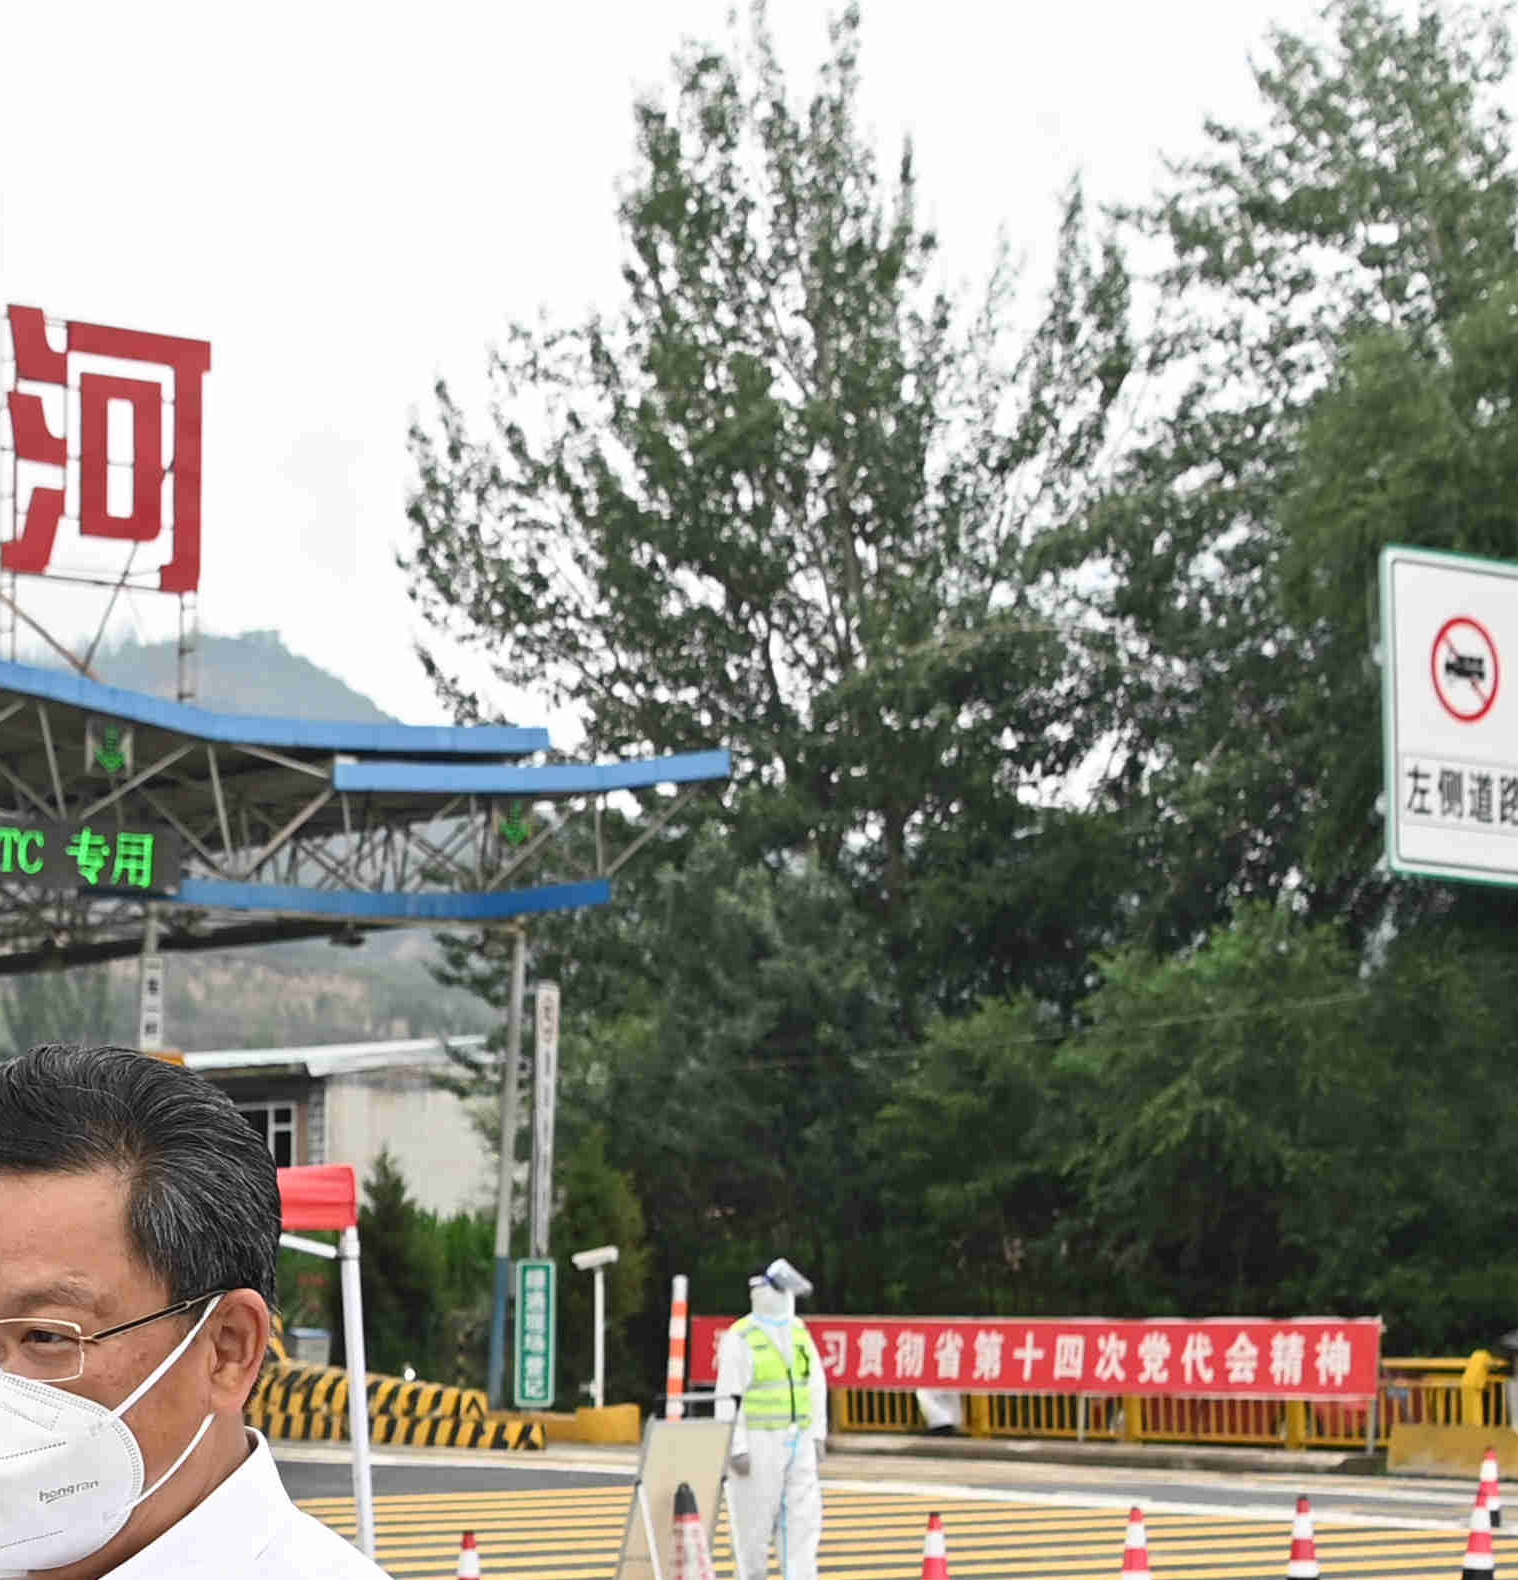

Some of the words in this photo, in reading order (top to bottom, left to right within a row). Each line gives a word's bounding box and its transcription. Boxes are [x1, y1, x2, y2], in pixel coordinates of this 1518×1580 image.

[65, 826, 155, 888] 专用
[712, 1328, 1352, 1386] 习贯彻省第十四次党代会精神
[39, 1480, 100, 1504] hongran
